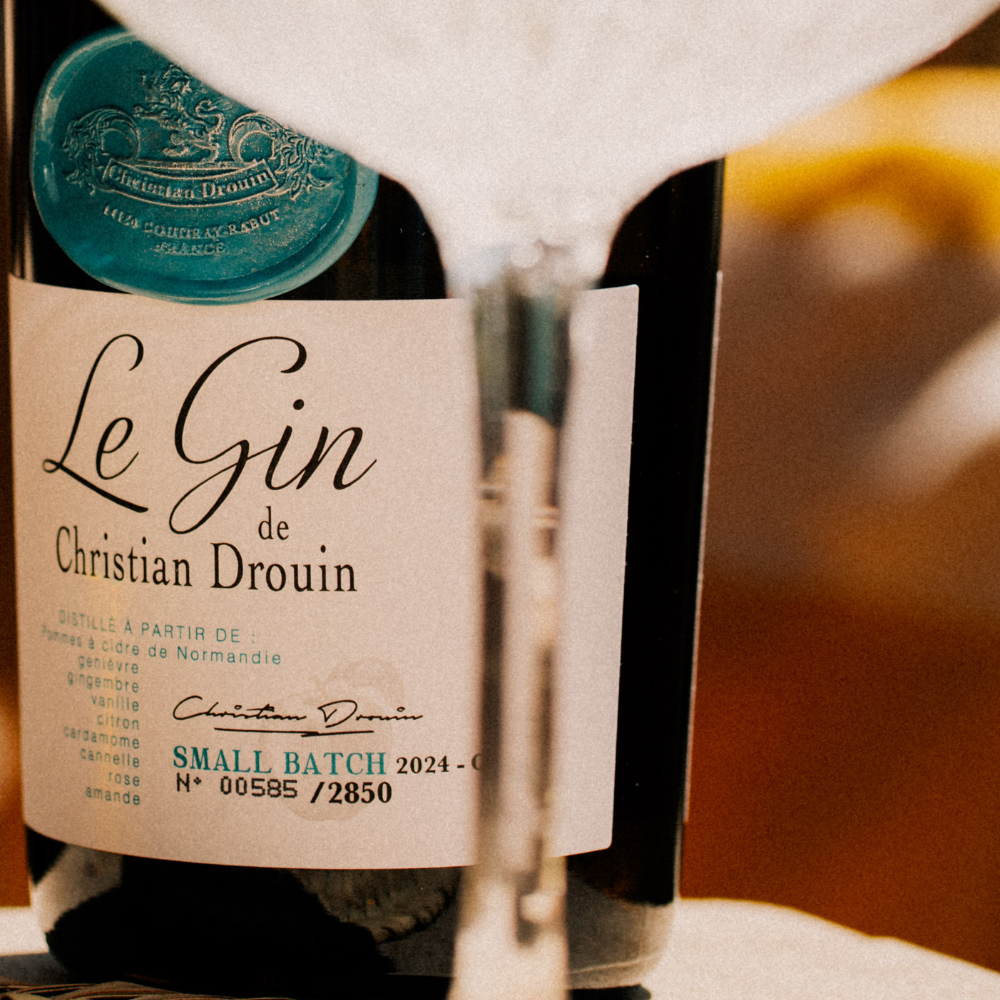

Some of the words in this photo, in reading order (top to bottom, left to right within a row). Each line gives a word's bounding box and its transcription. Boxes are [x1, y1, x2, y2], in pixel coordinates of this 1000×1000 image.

[202, 171, 269, 198] Drouin
[42, 333, 150, 513] Le
[169, 336, 378, 535] Gin
[257, 505, 290, 541] de
[55, 525, 193, 588] Christian
[210, 541, 358, 593] Drouin
[58, 609, 116, 634] DISTILLÉ
[123, 617, 133, 635] À
[141, 622, 205, 641] PARTIR
[216, 628, 241, 643] DE
[101, 638, 140, 656] cidre
[148, 643, 168, 659] de
[176, 645, 282, 666] Normandie
[78, 655, 140, 675] genièvre
[67, 671, 140, 693] gingembre
[90, 694, 140, 712] vanille
[96, 712, 140, 731] citron
[63, 726, 140, 750] cardamome
[80, 748, 141, 768] cannelle
[173, 745, 273, 774] SMALL
[283, 751, 387, 776] BATCH
[396, 755, 450, 775] 2024
[108, 772, 141, 788] rose
[220, 775, 298, 799] 00585
[310, 781, 393, 805] /2850
[85, 786, 141, 806] amande
